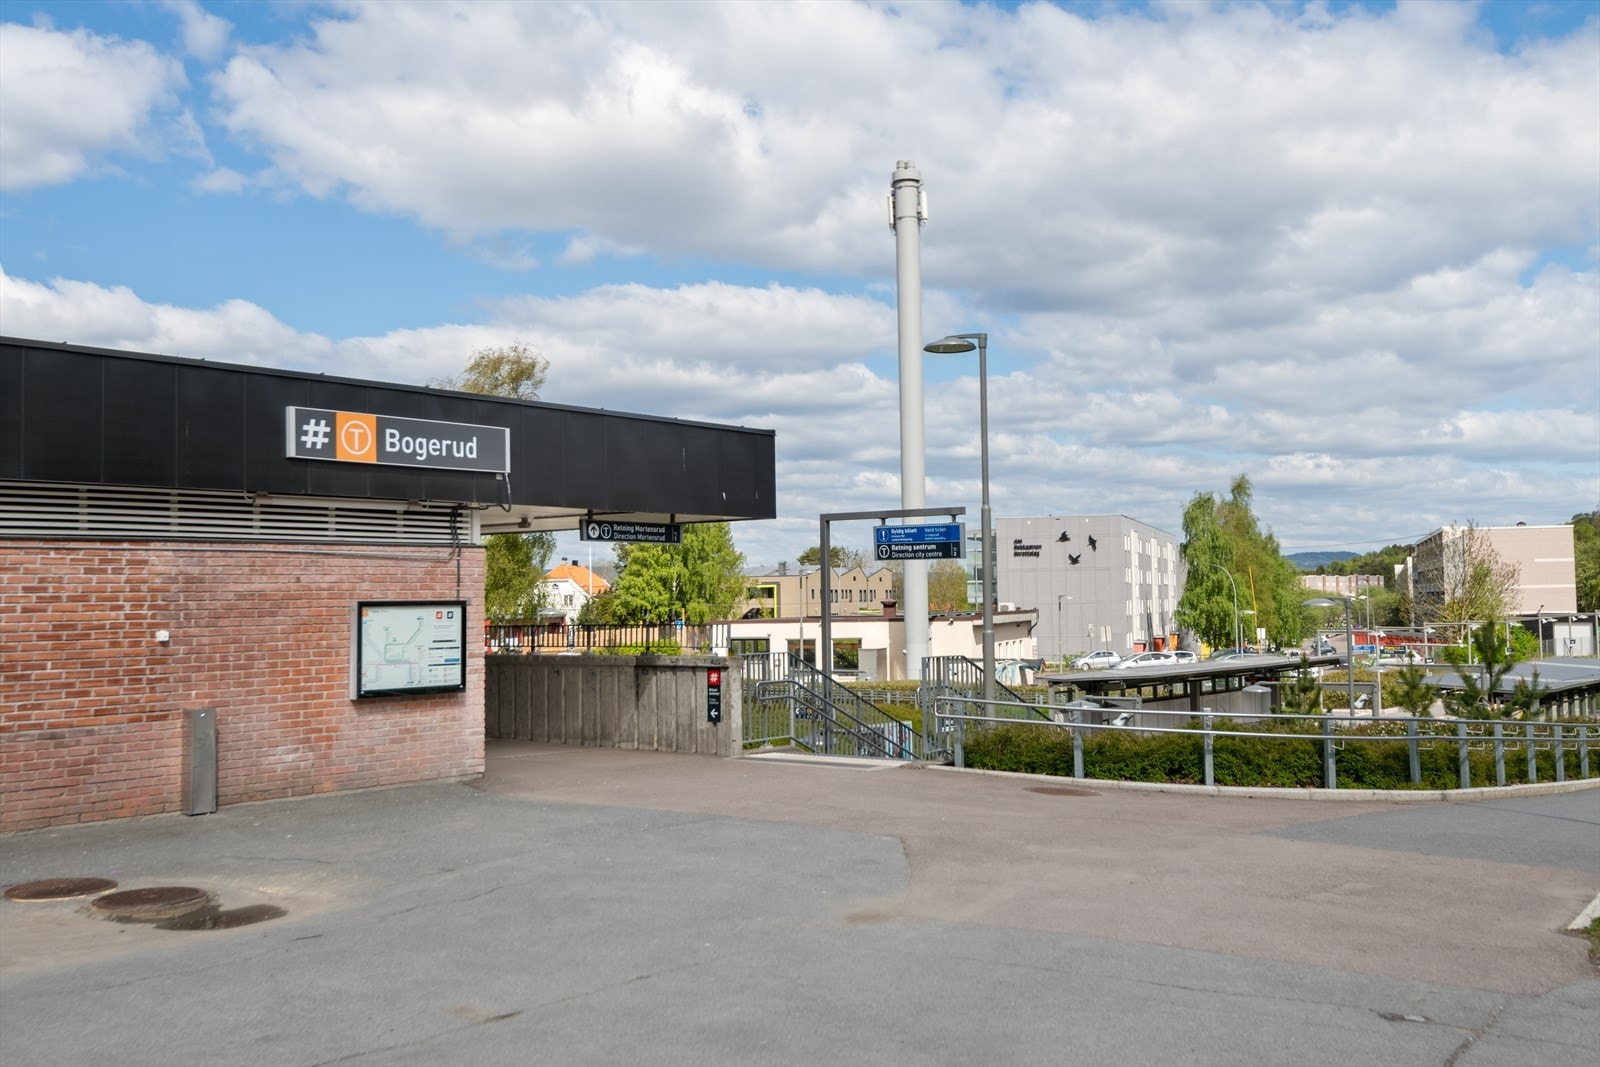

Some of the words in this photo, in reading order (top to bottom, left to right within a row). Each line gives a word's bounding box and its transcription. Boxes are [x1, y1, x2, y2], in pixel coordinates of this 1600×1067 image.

[385, 428, 477, 461] Bogerud
[613, 524, 634, 533] Retning
[635, 524, 665, 533] Mortensrud
[613, 532, 636, 540] Direction
[637, 533, 665, 541] Mortensrud
